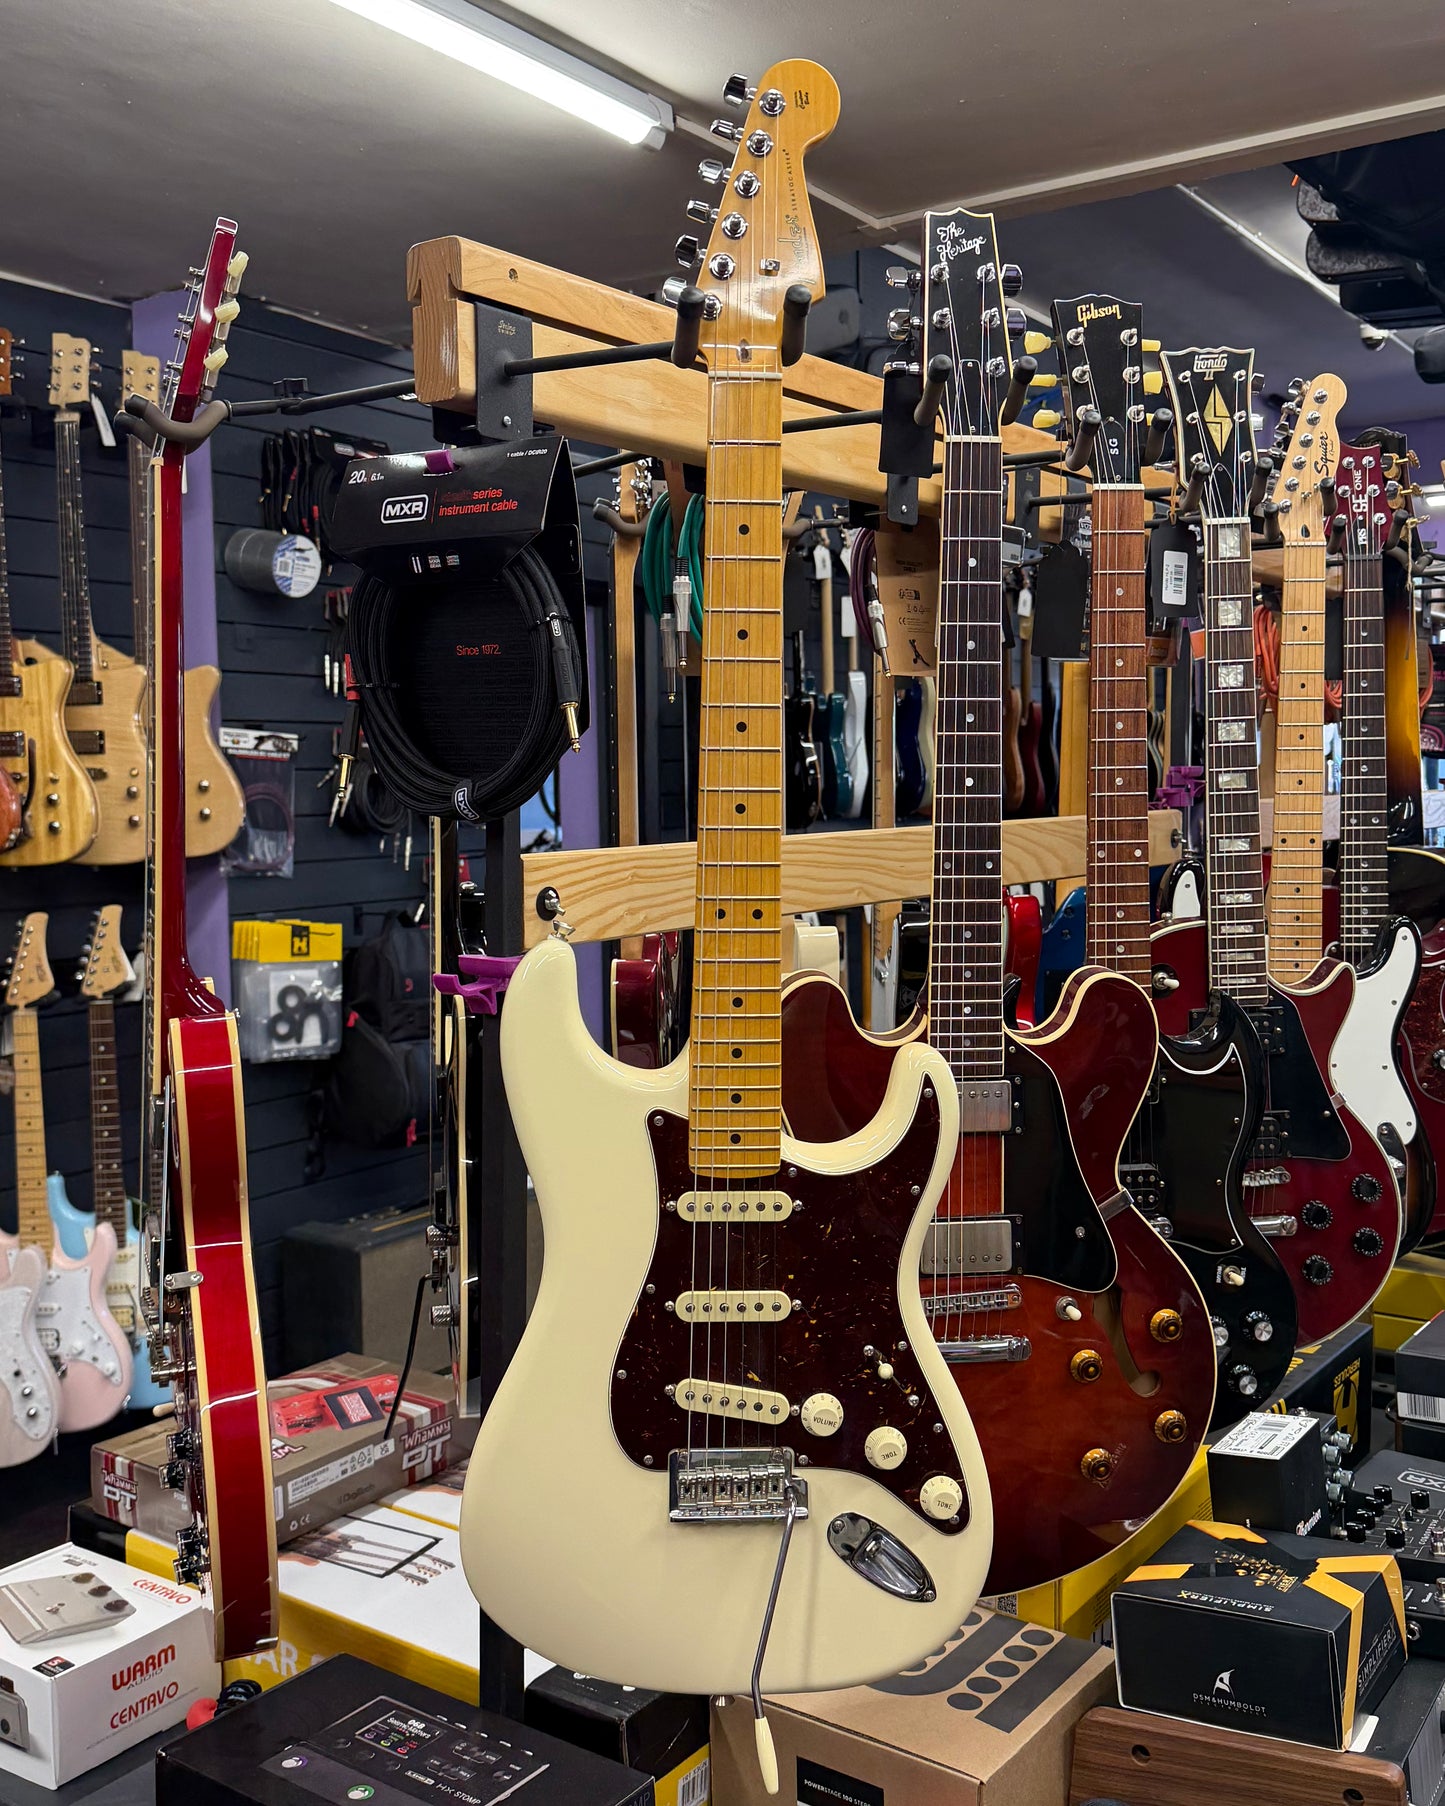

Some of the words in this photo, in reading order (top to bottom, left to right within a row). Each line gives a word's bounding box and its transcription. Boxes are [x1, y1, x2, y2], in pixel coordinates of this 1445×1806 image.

[936, 221, 965, 244] The
[936, 235, 987, 262] Heritage
[1076, 303, 1123, 329] Gibson
[1108, 437, 1119, 456] SG
[1314, 431, 1334, 477] Squier
[1354, 469, 1363, 491] ONE
[472, 487, 503, 500] series
[385, 501, 423, 517] MXR
[439, 501, 489, 517] instrument
[491, 498, 518, 512] cable
[456, 645, 480, 656] Since
[813, 1416, 838, 1429] VOLUME
[1406, 1473, 1445, 1490] XR
[936, 1500, 953, 1511] TONE
[133, 1578, 192, 1605] CENTAVO
[111, 1643, 176, 1691] WARM
[126, 1668, 163, 1691] AUDIO
[109, 1681, 179, 1729] CENTAVO
[1192, 1692, 1266, 1713] DSM&HUMBOLDT
[453, 1790, 482, 1806] STOMP
[804, 1778, 842, 1799] POWERSTAGE
